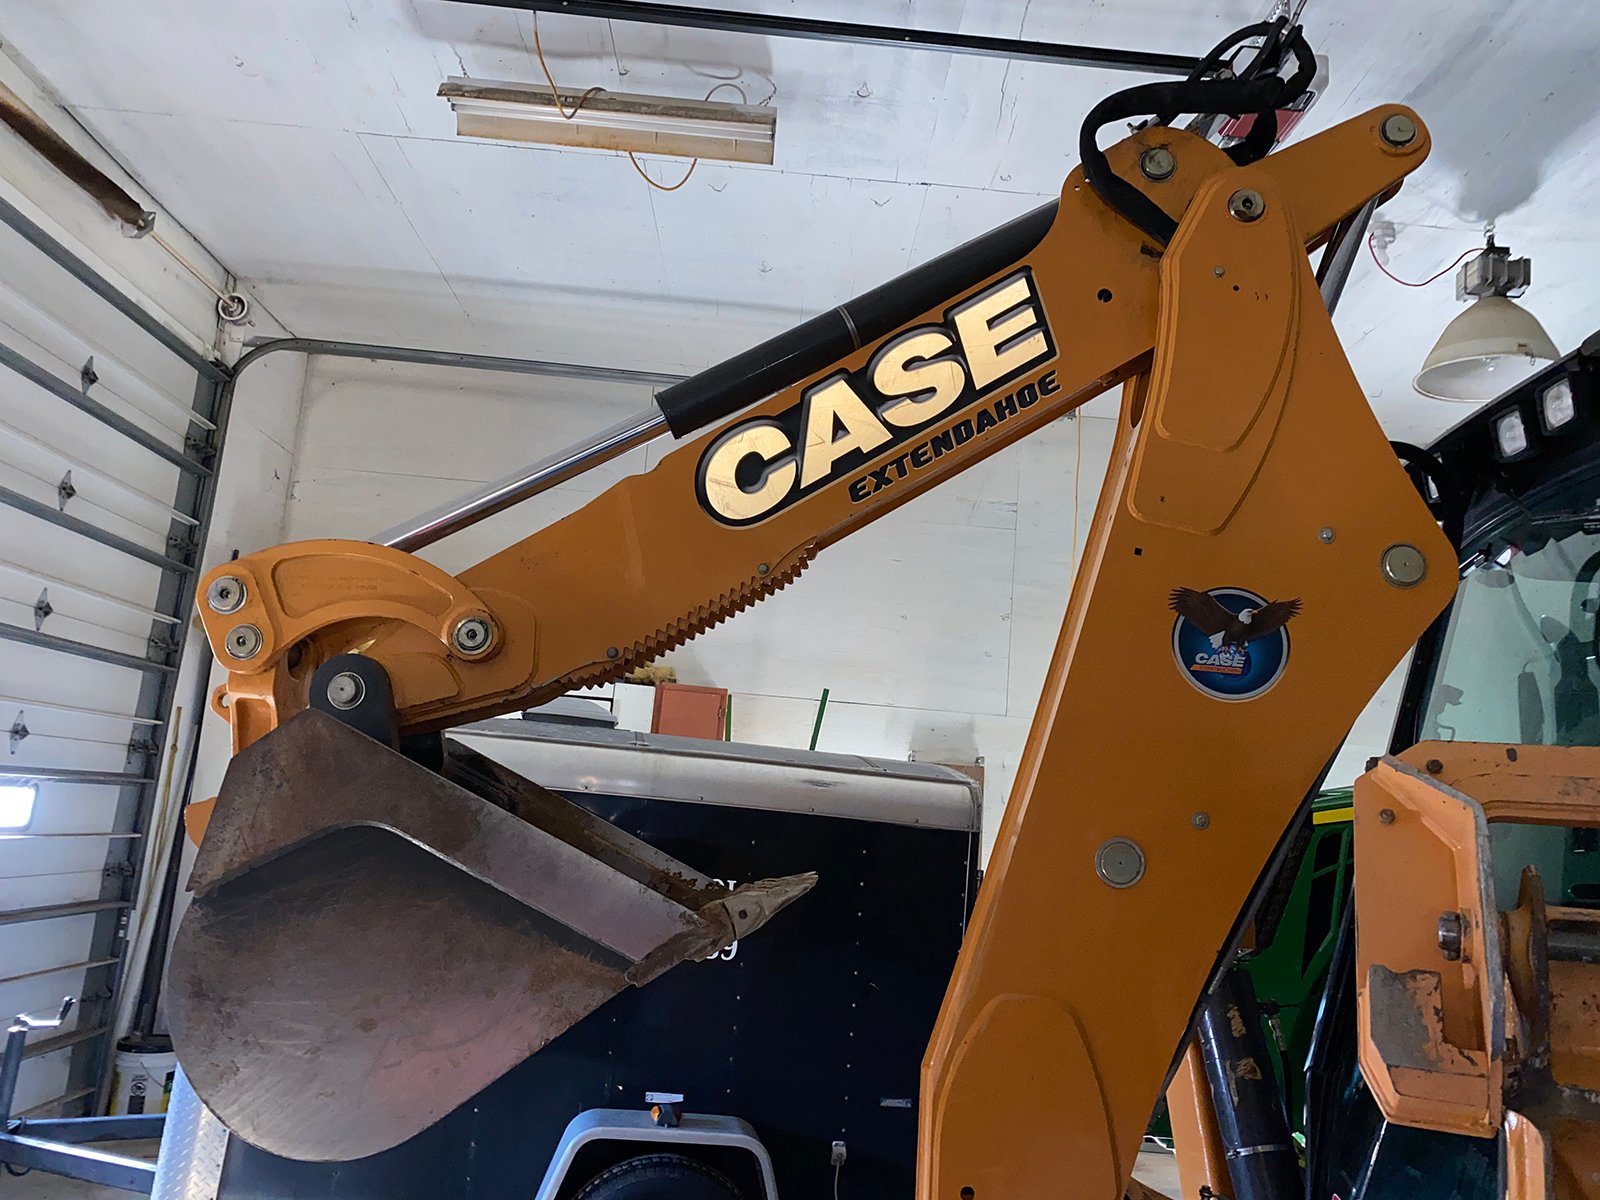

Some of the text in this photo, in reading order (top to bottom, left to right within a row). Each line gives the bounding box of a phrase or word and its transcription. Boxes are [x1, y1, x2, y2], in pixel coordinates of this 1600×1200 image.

[702, 274, 1052, 522] CASE
[849, 371, 1061, 503] EXTENDAHOE
[1195, 653, 1246, 668] CASE
